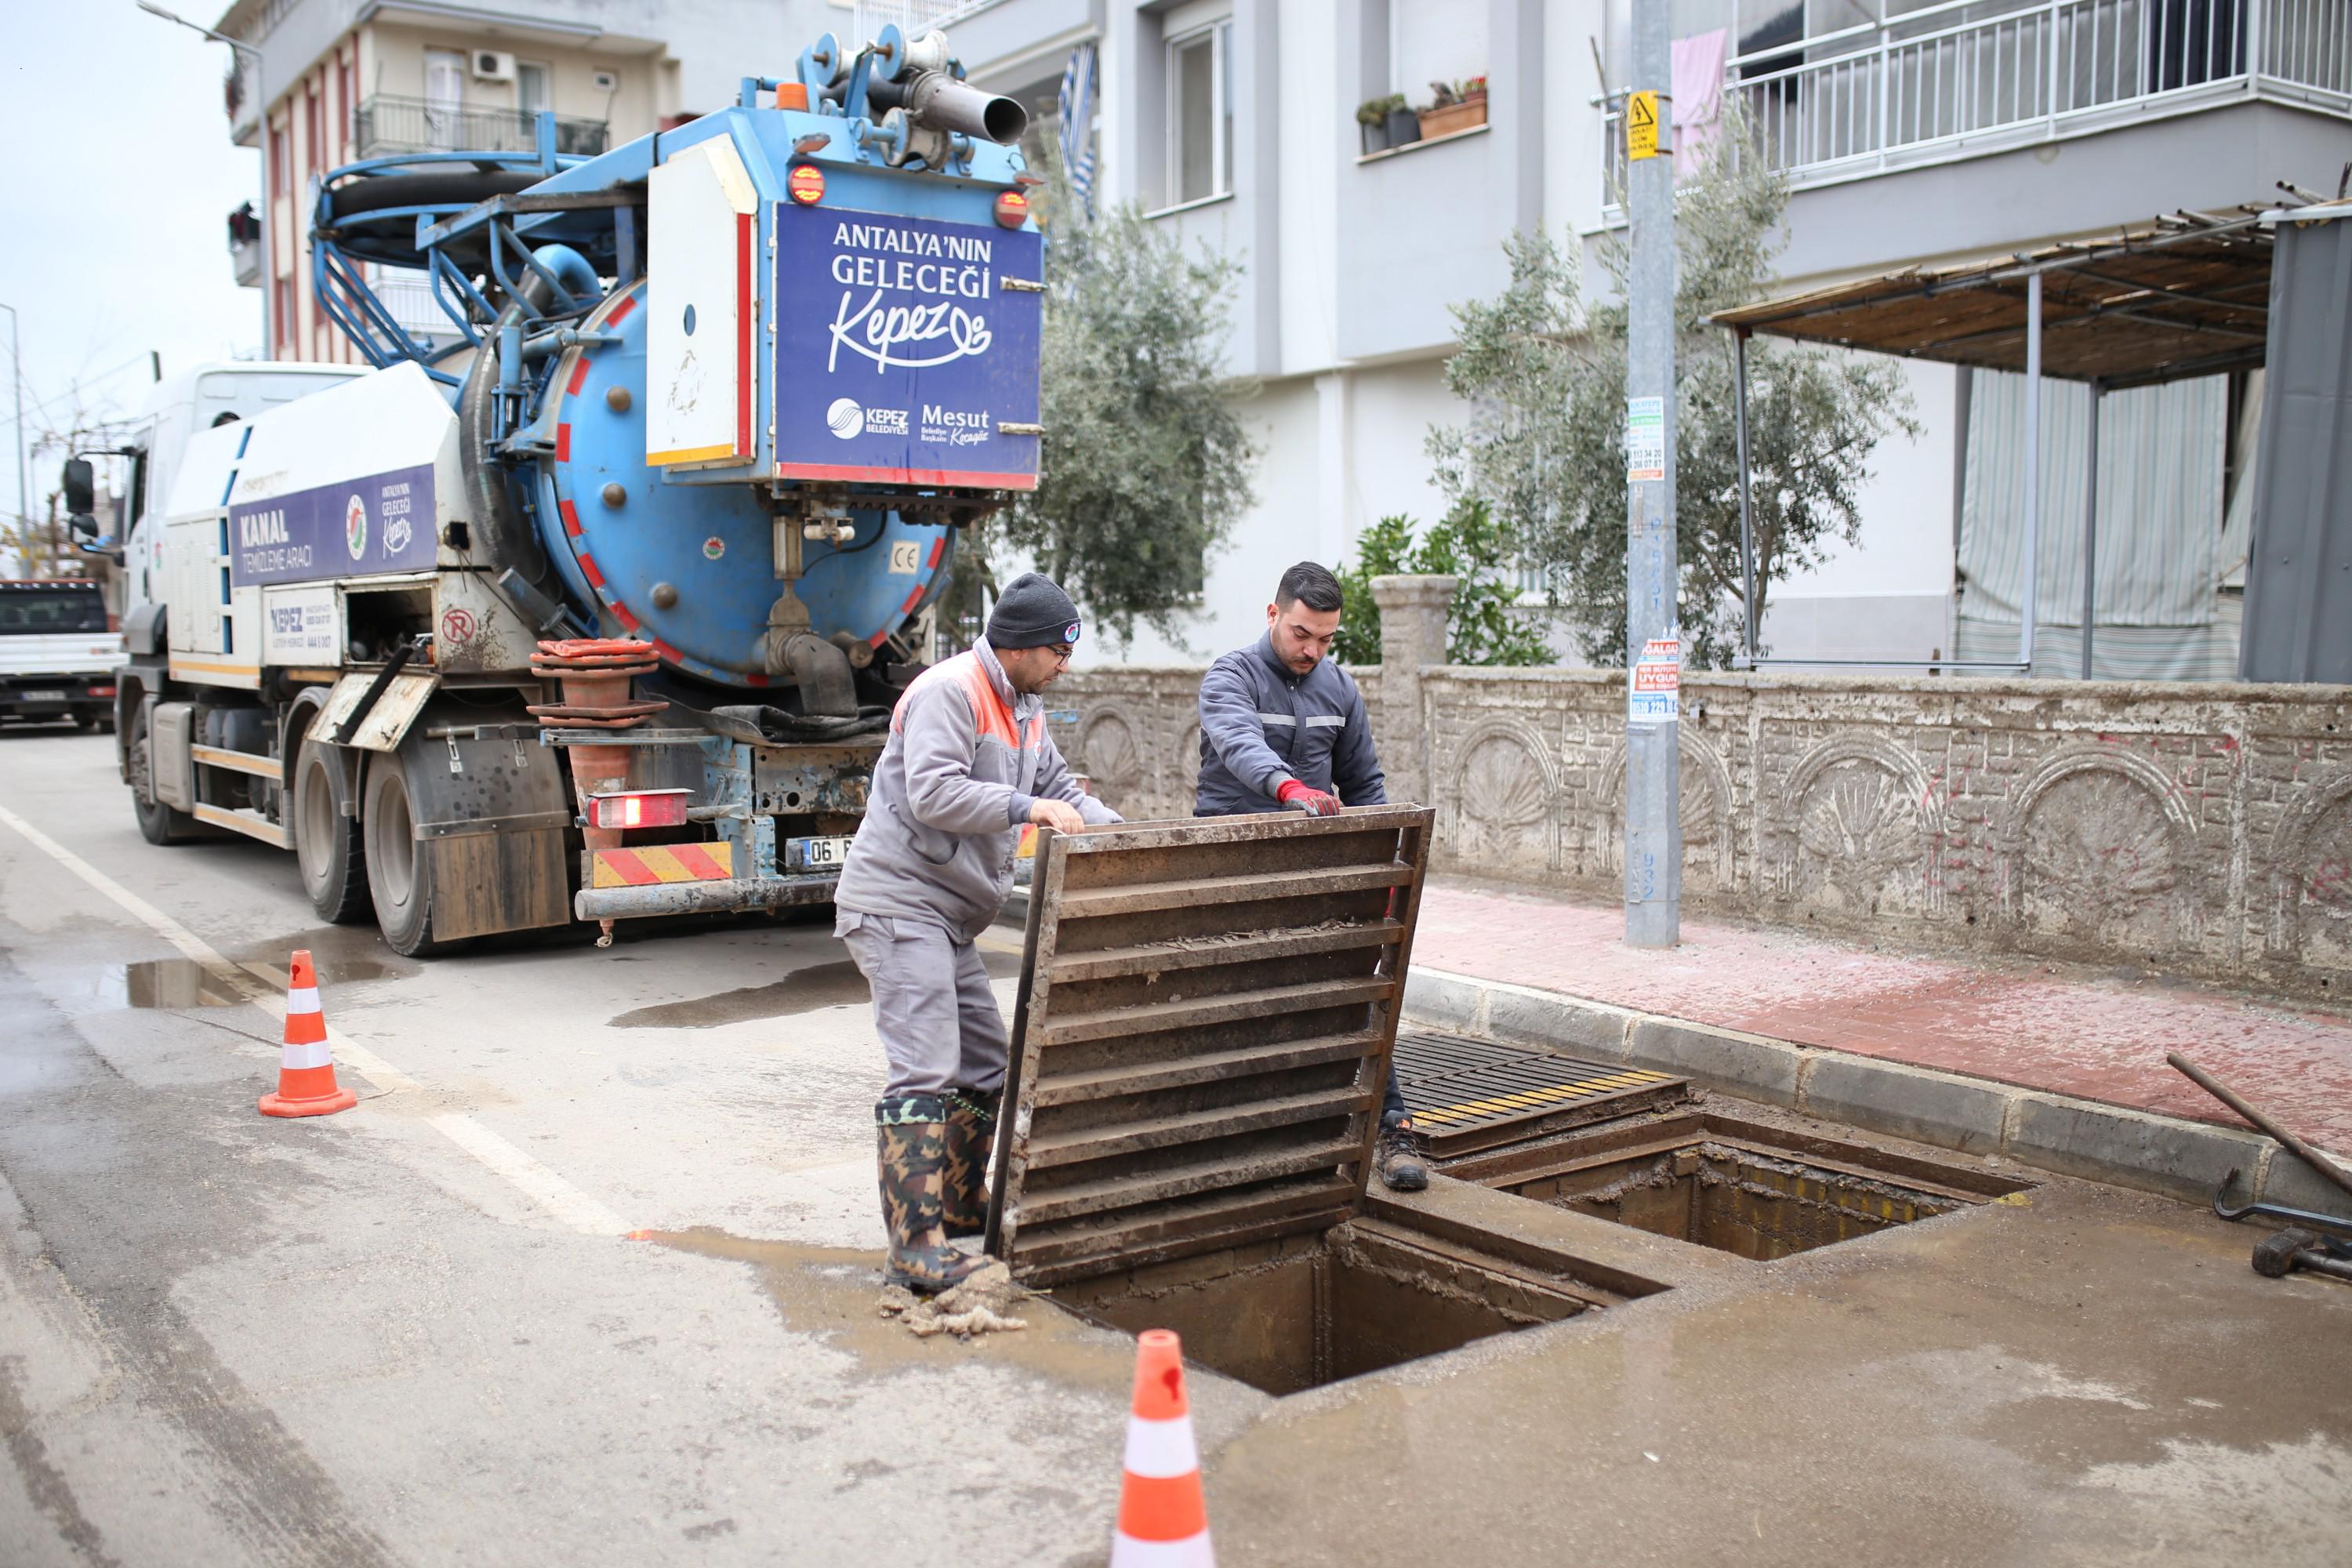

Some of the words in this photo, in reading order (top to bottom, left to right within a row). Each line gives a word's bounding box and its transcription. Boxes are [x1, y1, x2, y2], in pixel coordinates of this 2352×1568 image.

[833, 222, 992, 263] ANTALYA'NIN
[831, 254, 991, 299] GELECEĞİ
[828, 289, 964, 375] Kepez
[866, 408, 909, 426] KEPEZ
[921, 404, 990, 428] Mesut
[866, 424, 909, 436] BELEDİYESİ
[949, 427, 989, 446] Kocagöz
[240, 509, 289, 548] KANAL
[242, 548, 285, 573] TEMİZLEME
[285, 544, 313, 568] ARACI
[895, 547, 916, 568] CE
[270, 607, 303, 633] KEPEZ
[1639, 673, 1677, 684] UYGUN
[811, 841, 832, 862] 06
